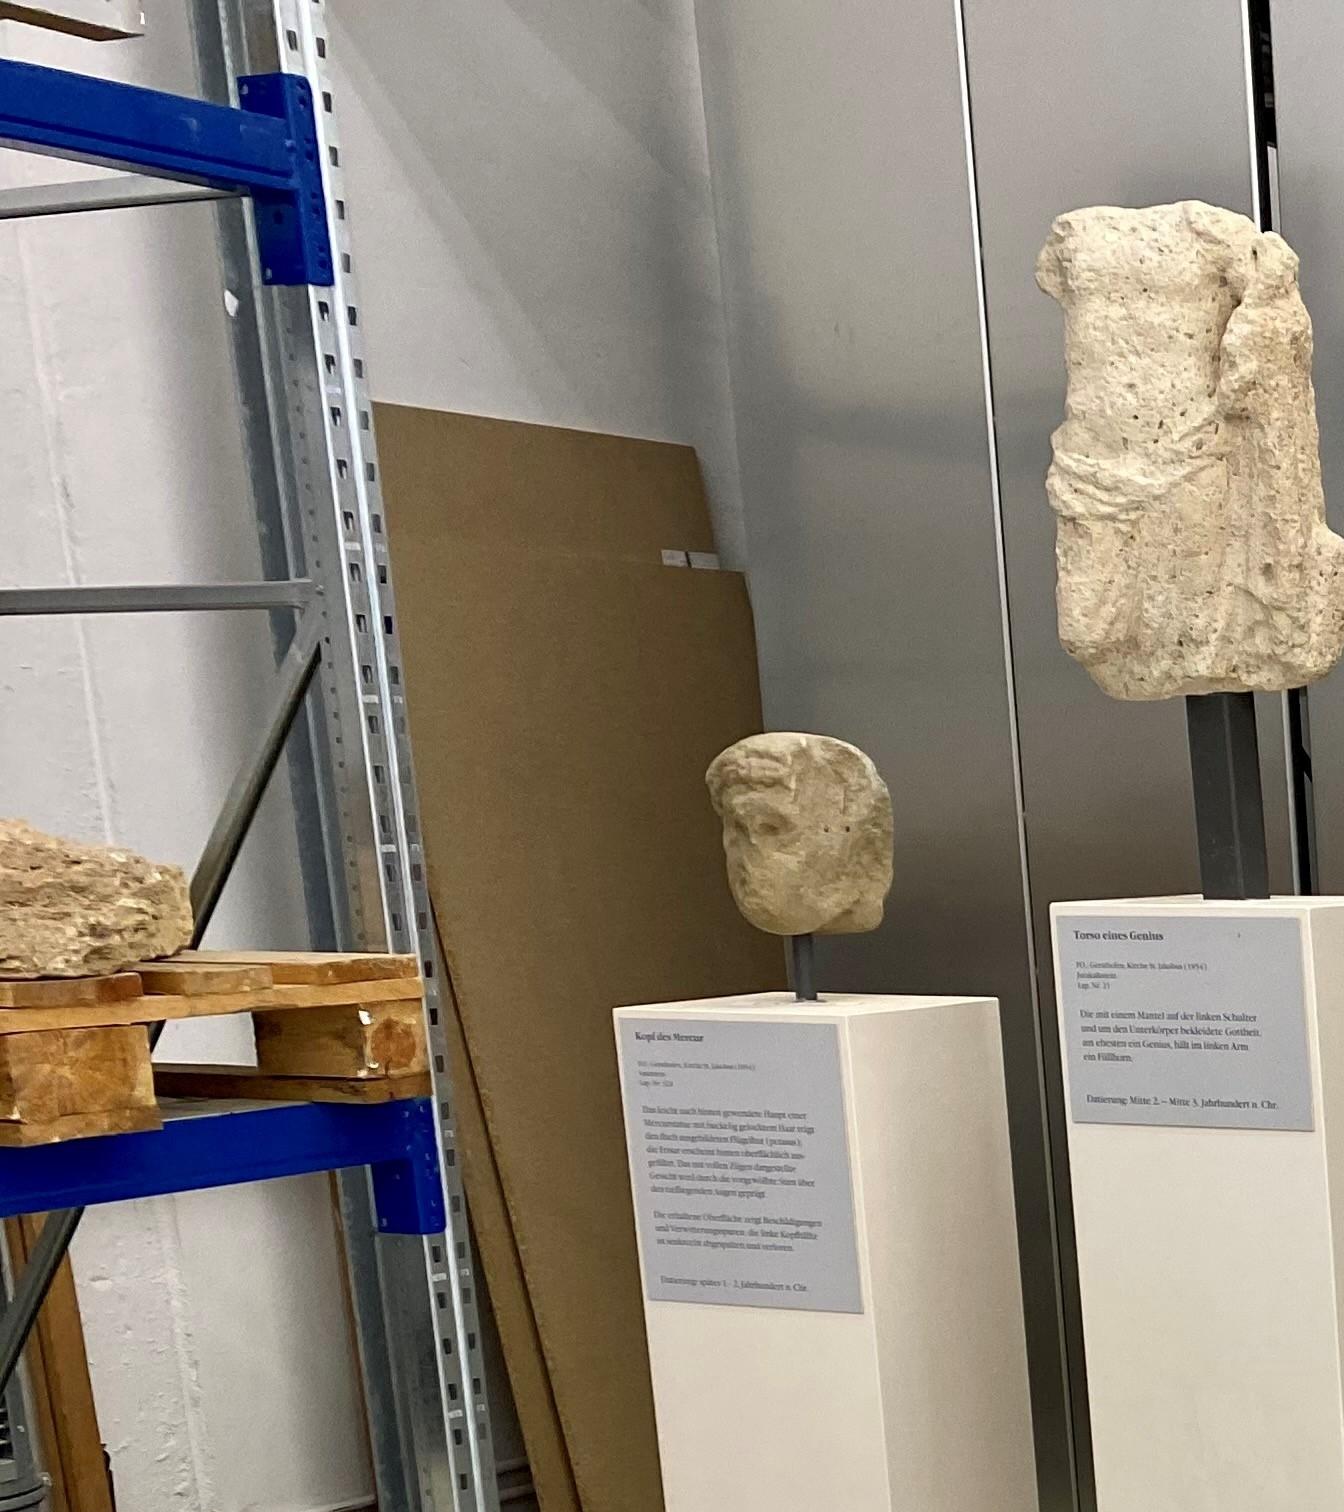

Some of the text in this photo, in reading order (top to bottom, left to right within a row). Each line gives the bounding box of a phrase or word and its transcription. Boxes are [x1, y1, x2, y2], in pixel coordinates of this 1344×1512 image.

[1072, 929, 1164, 941] Torso eines Genius
[1110, 1009, 1135, 1019] einem
[1137, 1010, 1165, 1020] Mantel
[1165, 1011, 1179, 1021] auf
[1179, 1011, 1194, 1021] der
[1195, 1011, 1221, 1022] linken
[1221, 1012, 1257, 1023] Schulter
[1080, 1023, 1097, 1033] und
[1111, 1024, 1128, 1034] den
[1128, 1024, 1178, 1036] Unterkörper
[1179, 1026, 1223, 1037] bekleidete
[634, 1031, 656, 1043] Kopf
[655, 1031, 672, 1043] des
[1190, 1041, 1202, 1051] im
[1203, 1041, 1229, 1051] linken
[1229, 1042, 1249, 1052] Arm
[1082, 1051, 1096, 1061] ein
[1199, 1097, 1250, 1110] Jahrhundert
